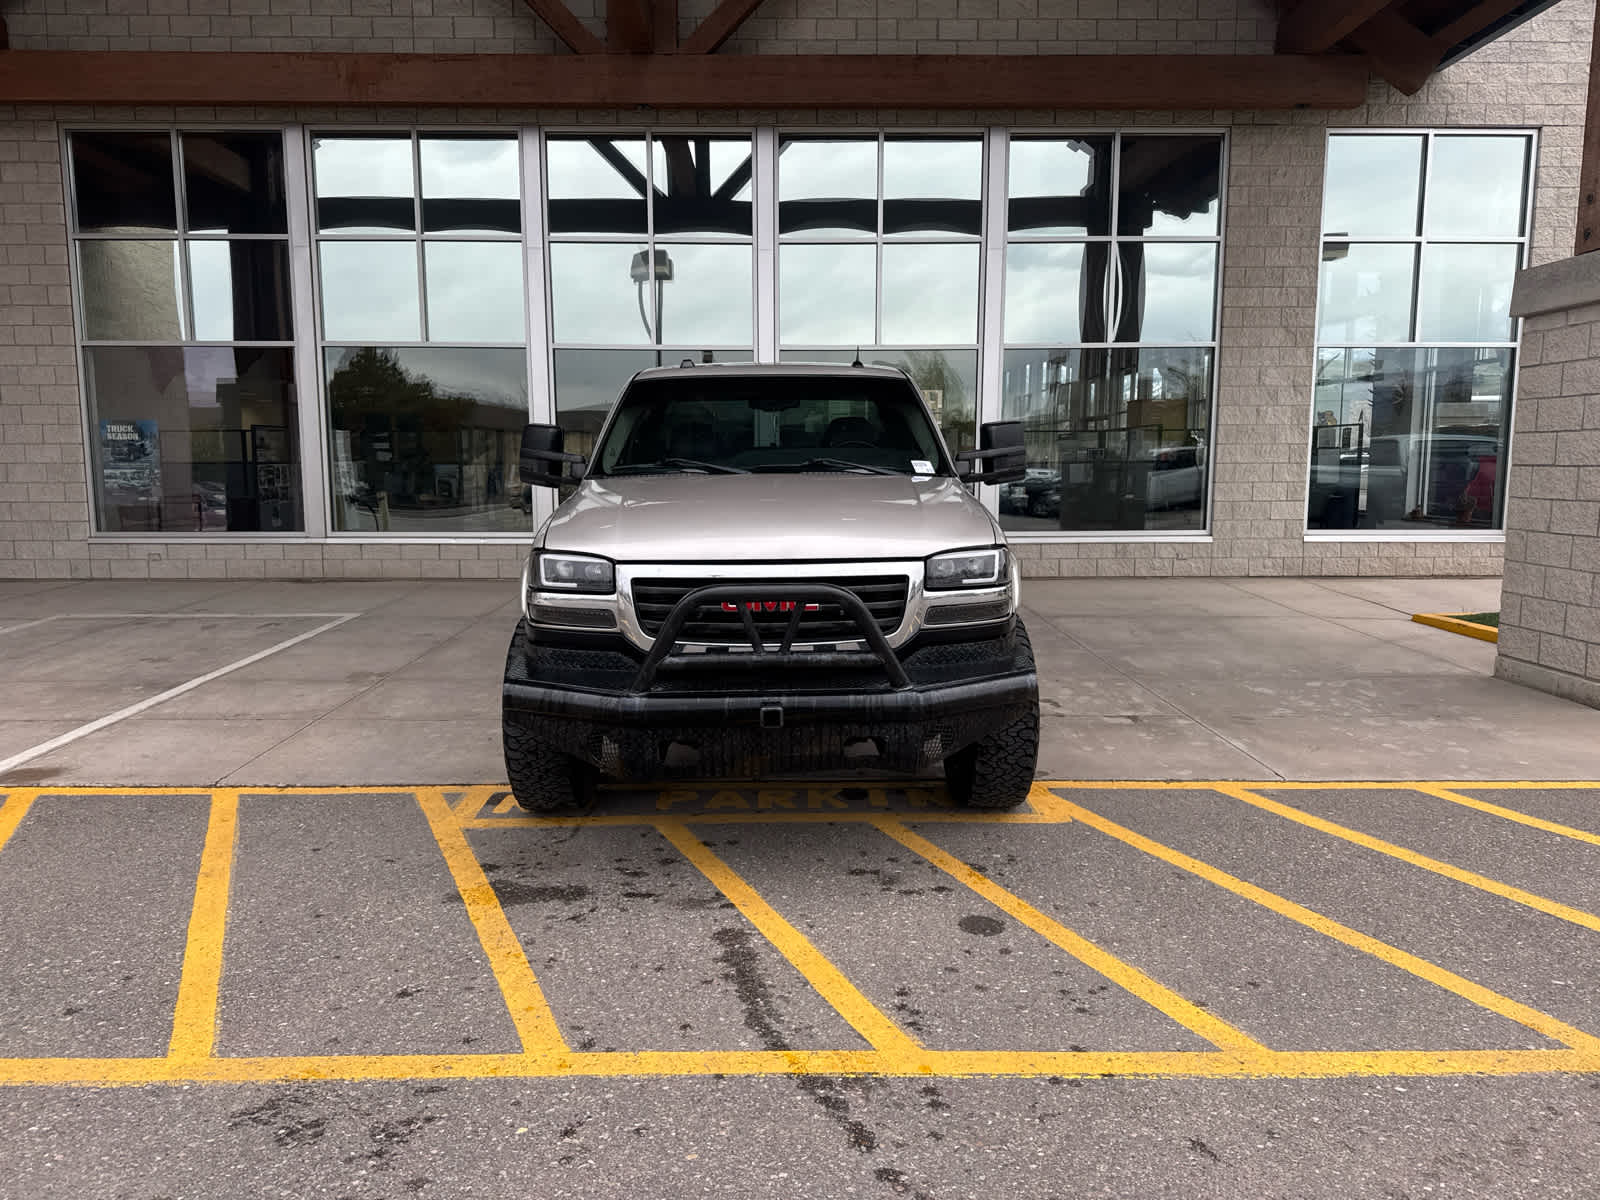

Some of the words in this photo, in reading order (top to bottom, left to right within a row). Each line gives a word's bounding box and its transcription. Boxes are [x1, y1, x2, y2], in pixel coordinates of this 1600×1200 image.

[106, 424, 134, 432] TRUCK
[107, 432, 139, 440] SEASON
[655, 790, 960, 811] PARKIN
